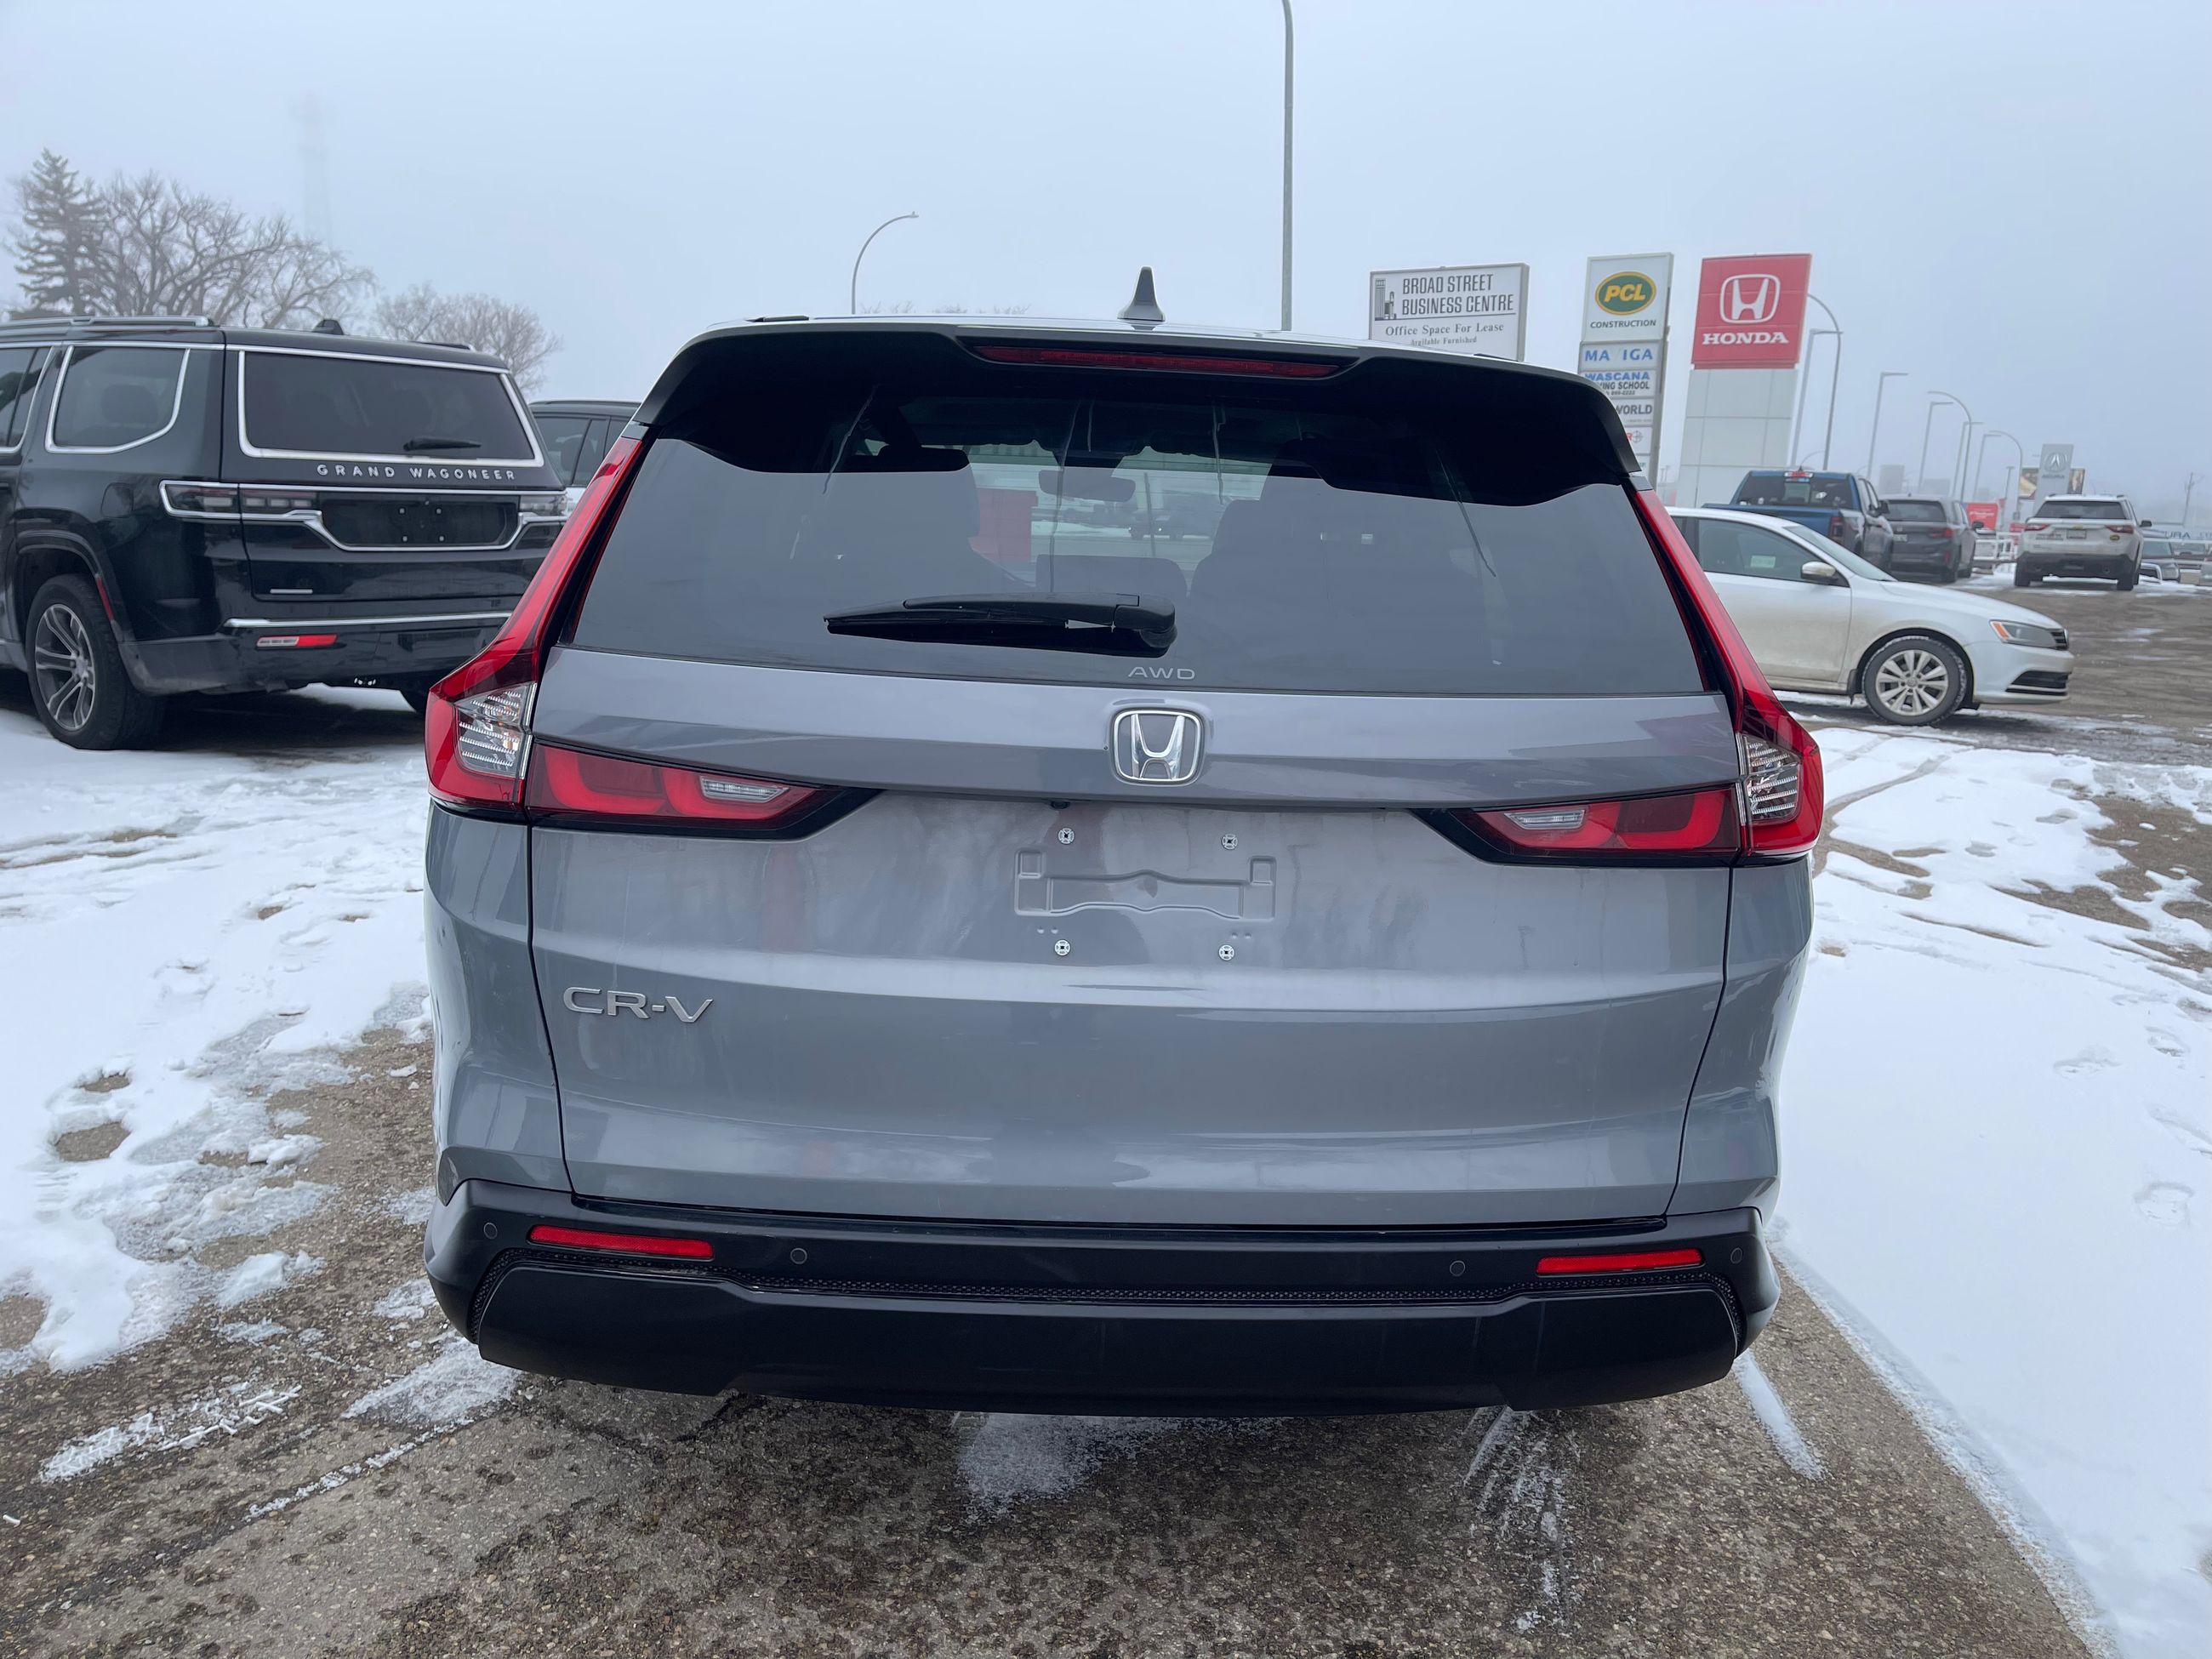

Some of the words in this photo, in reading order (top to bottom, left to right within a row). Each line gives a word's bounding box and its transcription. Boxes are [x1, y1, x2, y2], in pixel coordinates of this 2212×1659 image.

[1403, 276, 1444, 294] BROAD
[1447, 274, 1494, 293] STREET
[1604, 283, 1646, 303] PCL
[1402, 296, 1462, 315] BUSINESS
[1466, 294, 1514, 312] CENTRE
[1385, 326, 1418, 336] Office
[1422, 325, 1451, 336] Space
[1455, 323, 1472, 334] For
[1476, 322, 1504, 333] Lease
[1590, 319, 1656, 328] CONSTRUCTION
[1702, 332, 1789, 345] HONDA
[1584, 372, 1650, 381] WASCANA
[1617, 381, 1650, 390] SCHOOL
[316, 465, 396, 478] GRAND
[409, 467, 515, 480] WAGONEER
[1128, 666, 1195, 680] AWD
[562, 986, 714, 1023] CR-V
